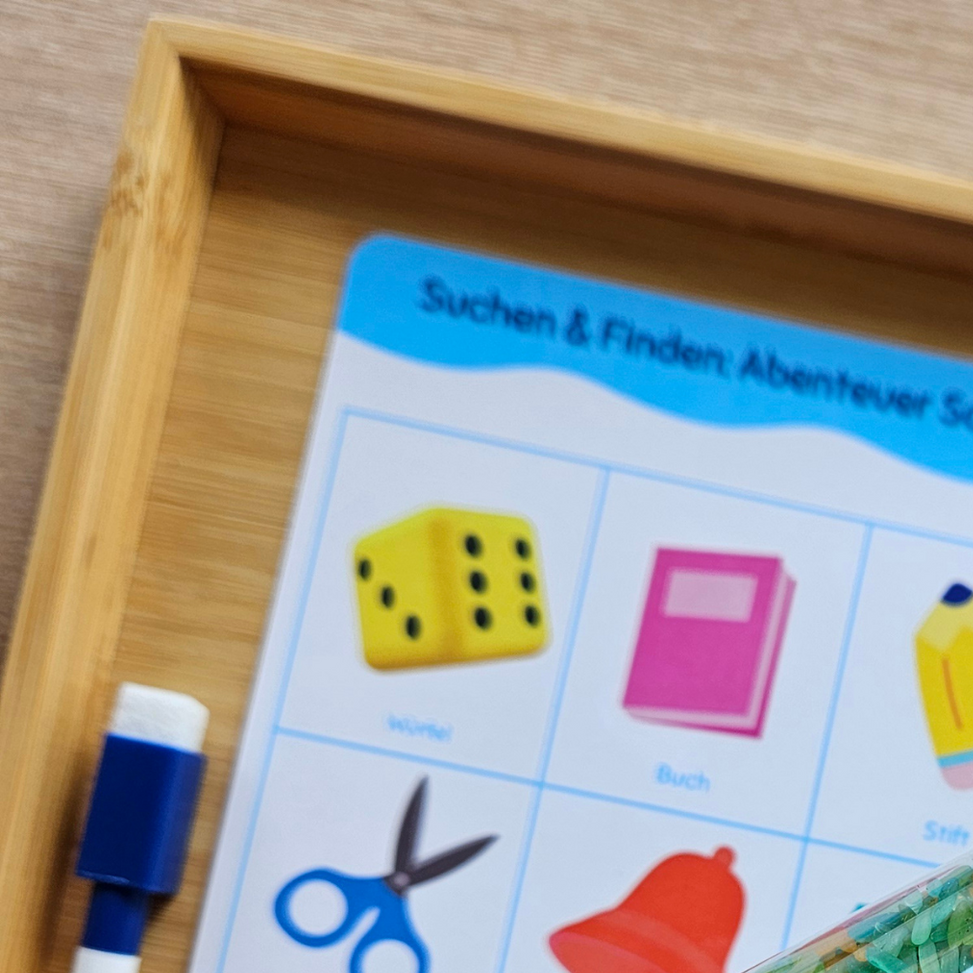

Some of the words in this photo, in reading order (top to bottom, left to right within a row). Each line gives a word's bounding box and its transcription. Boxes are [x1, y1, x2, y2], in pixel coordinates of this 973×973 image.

[419, 276, 556, 336] Suchen
[564, 304, 590, 347] &
[738, 346, 928, 418] Abenteuer
[656, 762, 711, 792] Buch
